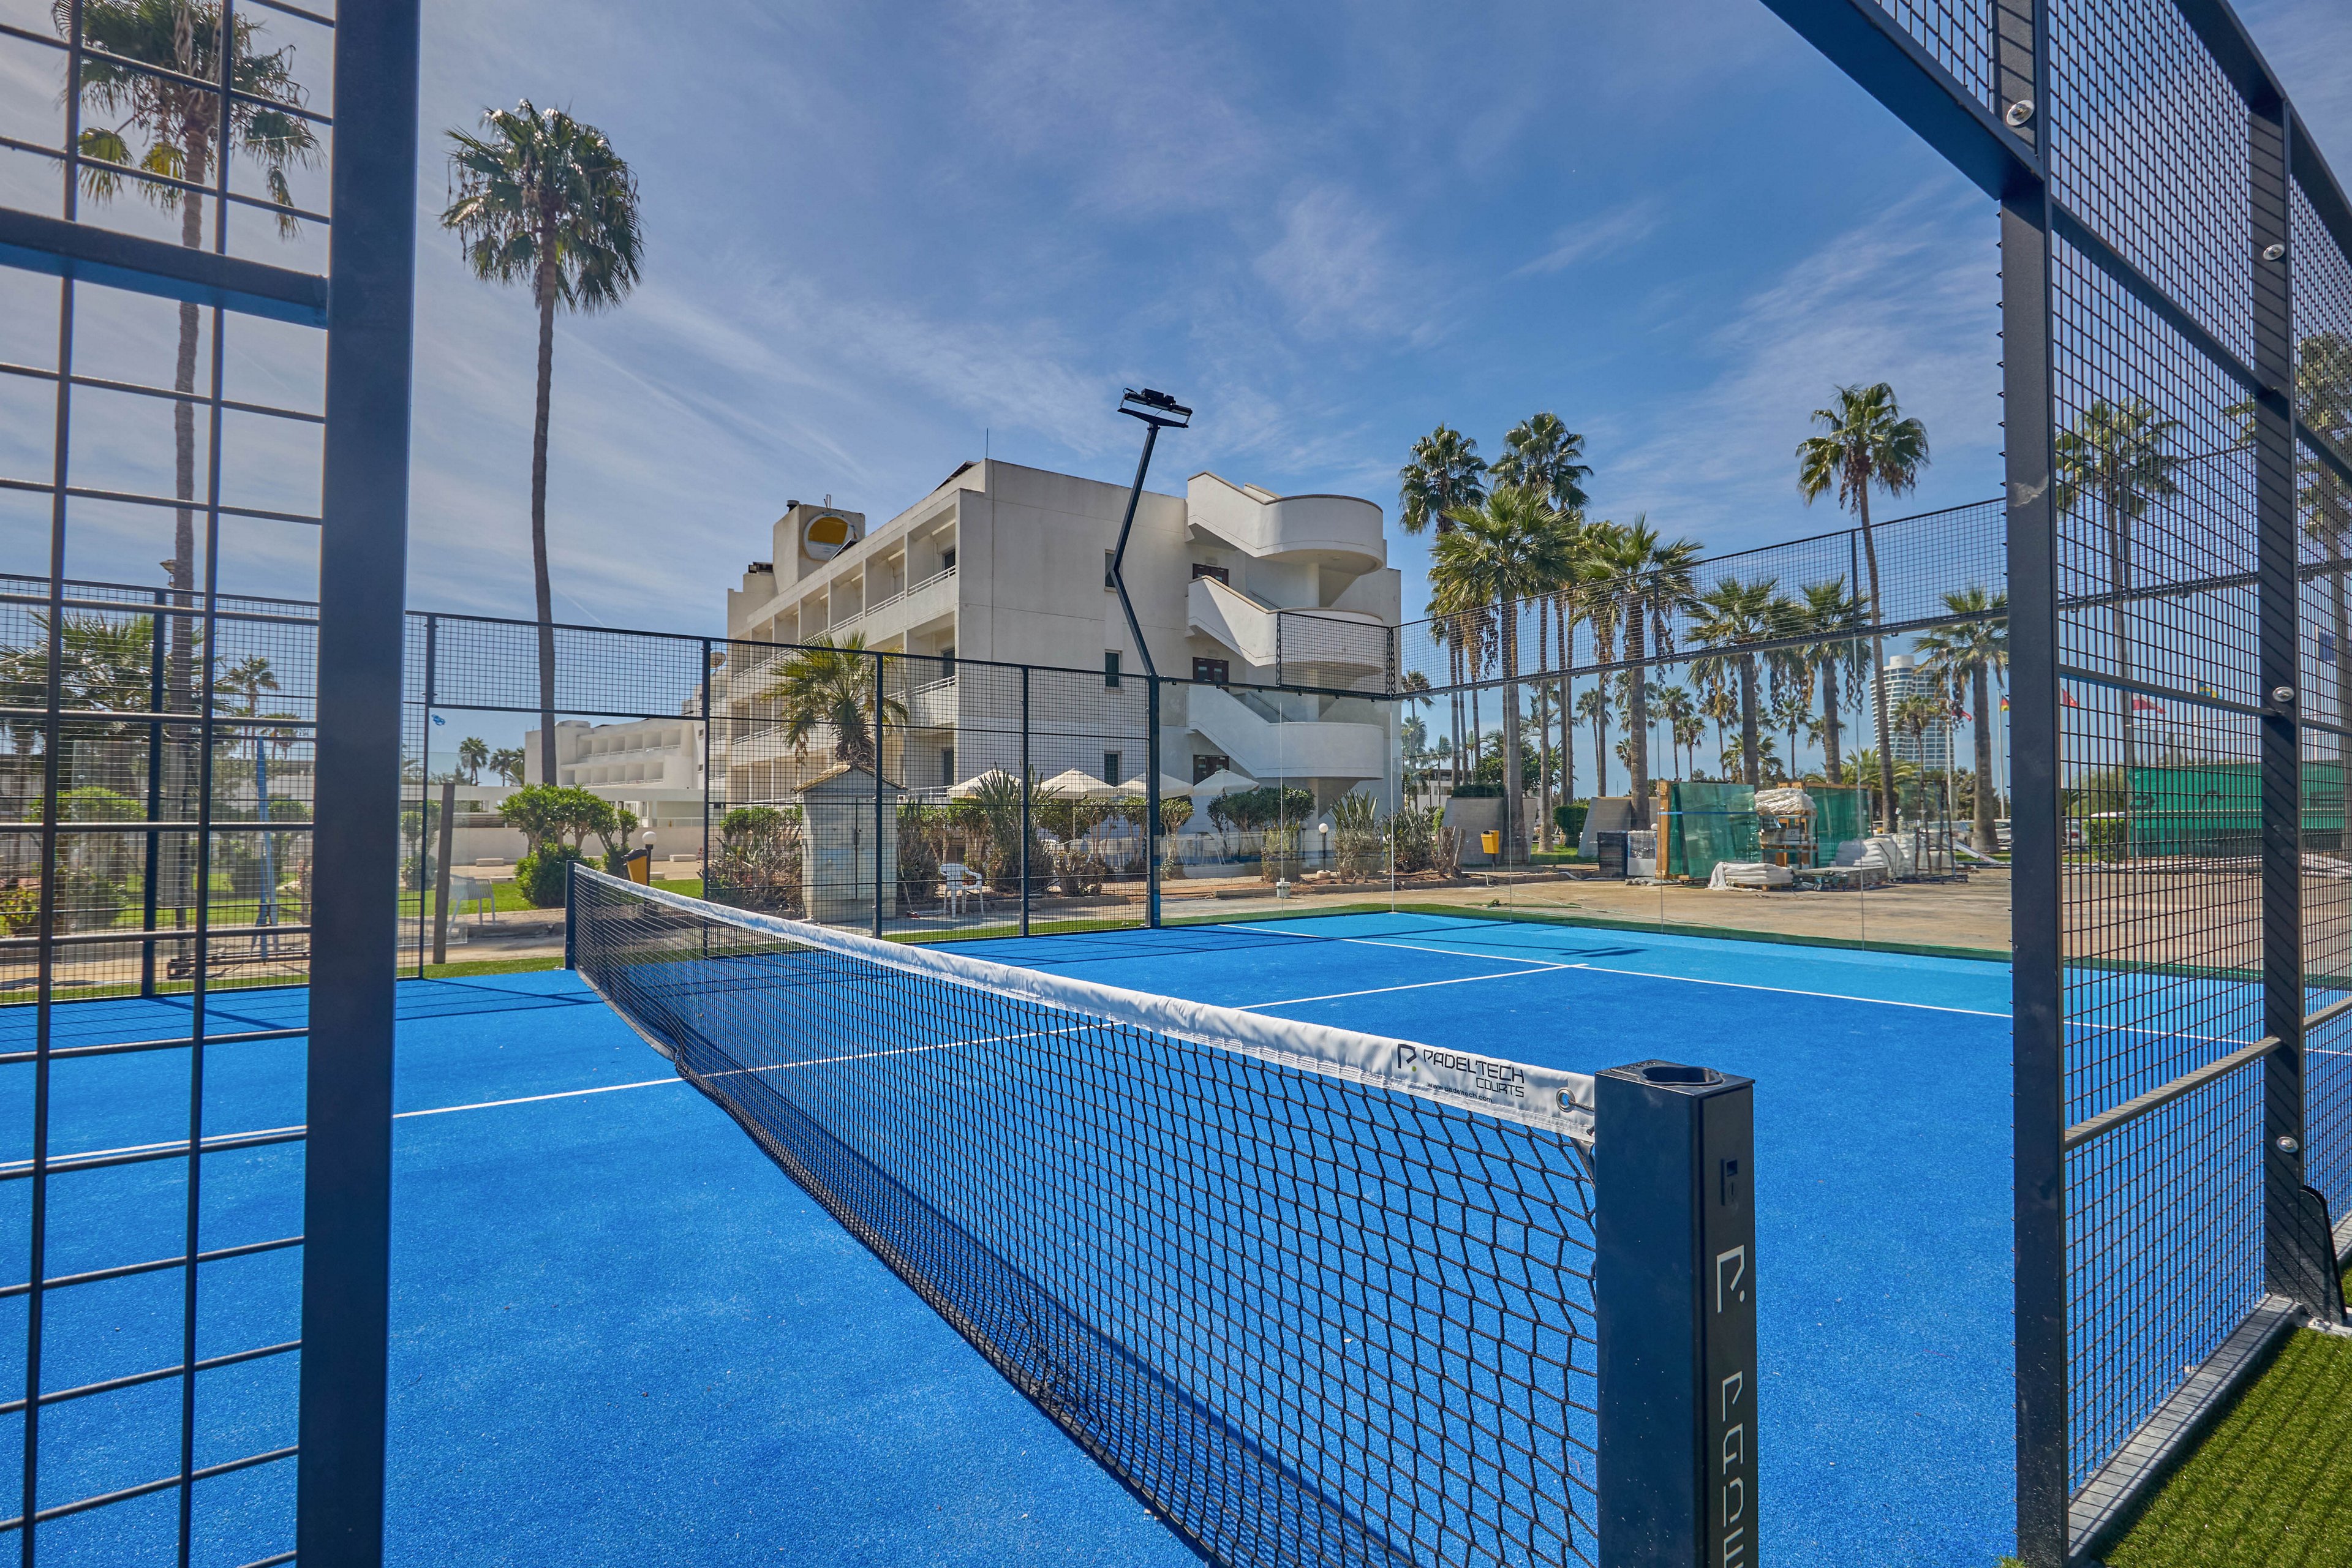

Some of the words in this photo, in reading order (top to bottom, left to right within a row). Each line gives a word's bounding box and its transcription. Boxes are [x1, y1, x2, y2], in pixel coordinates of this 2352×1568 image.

[1423, 1049, 1525, 1084] PADELTECH
[1427, 1082, 1493, 1103] www.padeltech.com
[1476, 1077, 1525, 1098] COURTS
